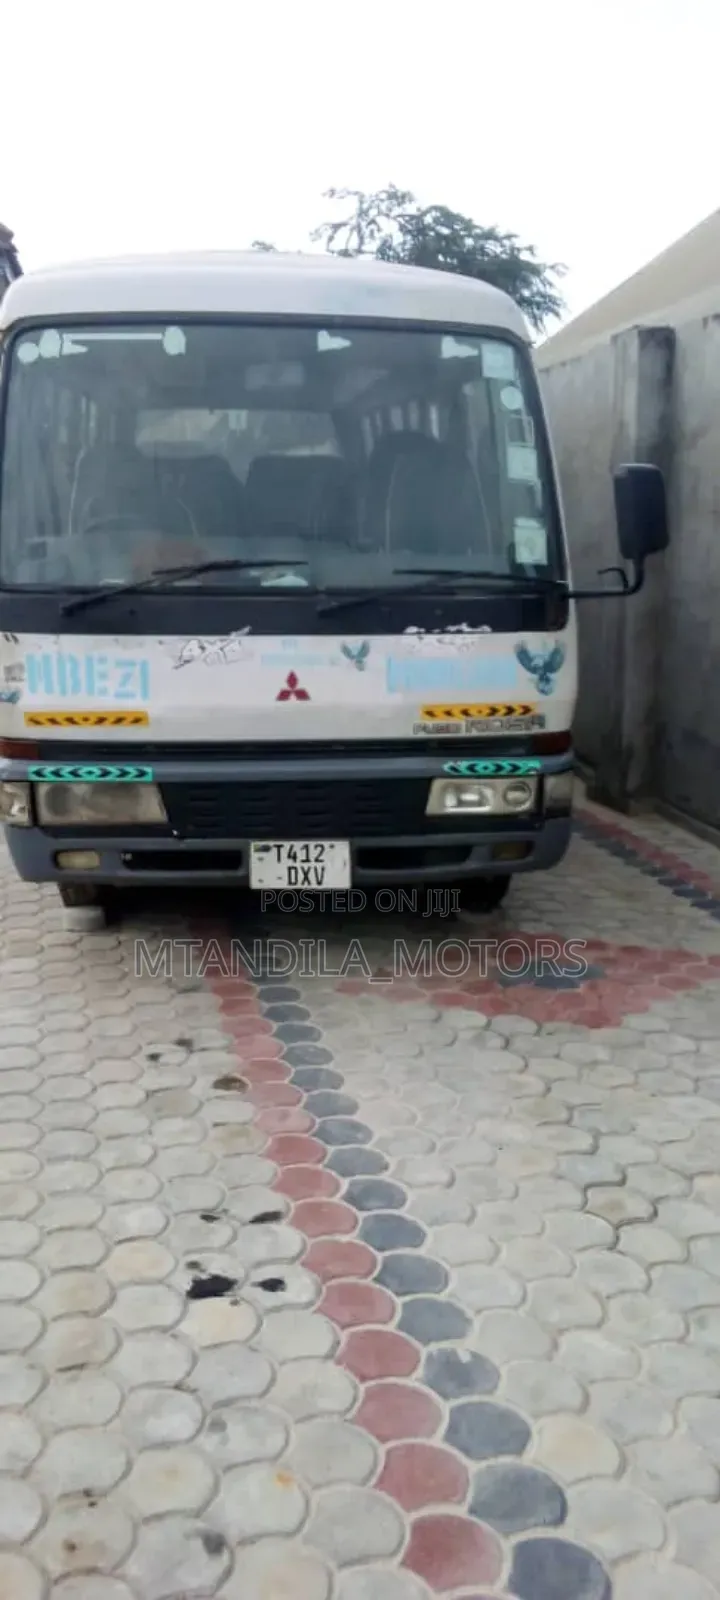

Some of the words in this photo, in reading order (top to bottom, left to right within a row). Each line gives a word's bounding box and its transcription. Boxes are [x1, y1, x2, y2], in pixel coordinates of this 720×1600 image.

[25, 652, 150, 699] MBEZI
[273, 844, 325, 863] T412
[287, 866, 325, 886] DXV
